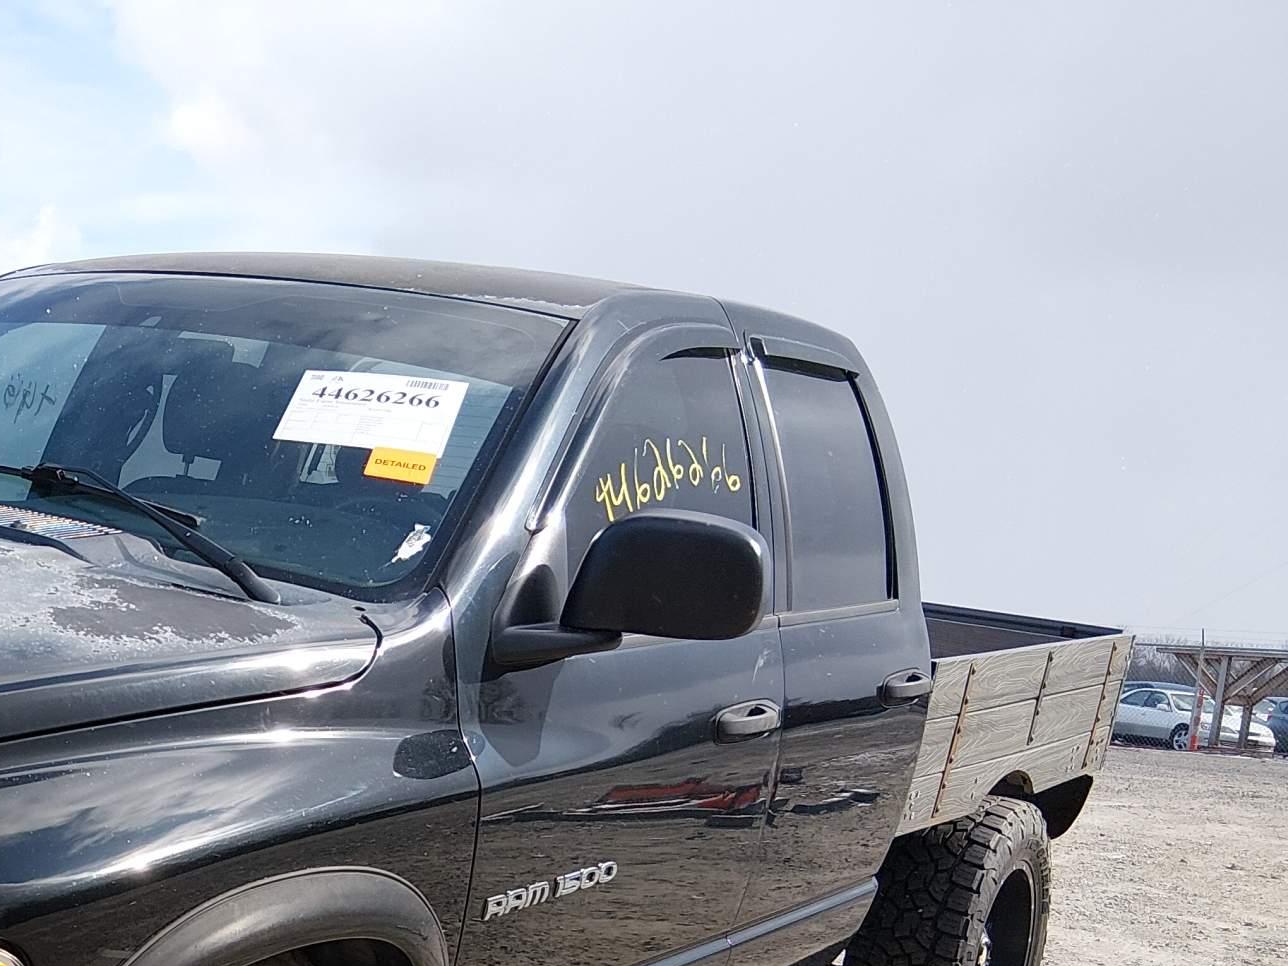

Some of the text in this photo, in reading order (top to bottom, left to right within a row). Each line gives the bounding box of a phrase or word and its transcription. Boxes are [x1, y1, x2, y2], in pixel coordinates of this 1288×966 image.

[311, 385, 443, 409] 44626266
[374, 458, 427, 472] DETAILED
[481, 860, 618, 921] RAM 1500
